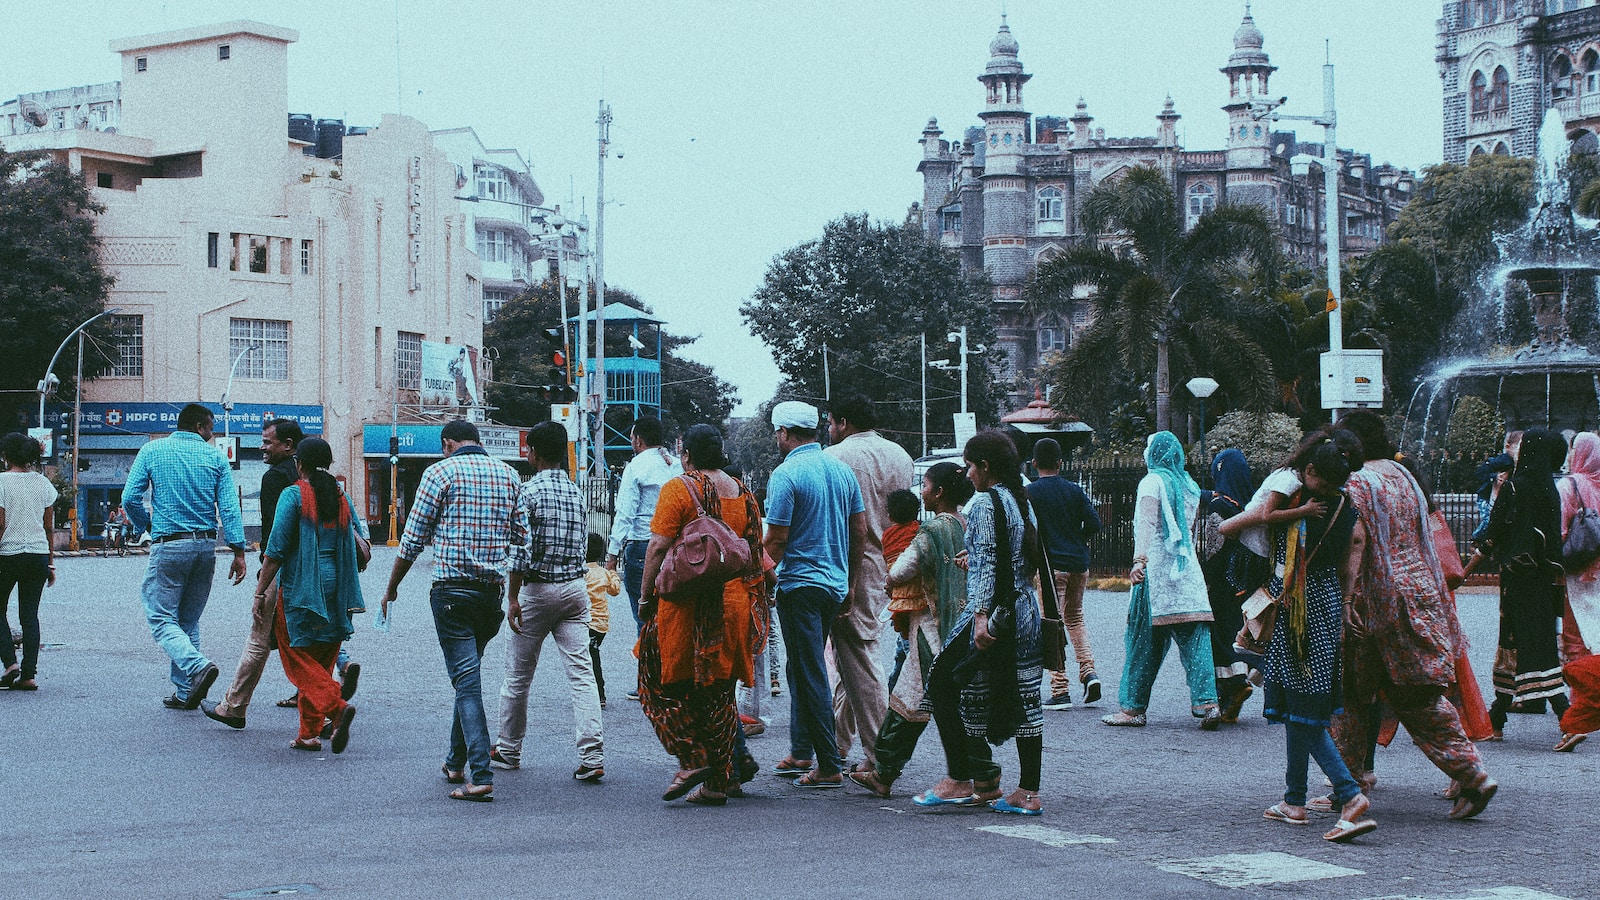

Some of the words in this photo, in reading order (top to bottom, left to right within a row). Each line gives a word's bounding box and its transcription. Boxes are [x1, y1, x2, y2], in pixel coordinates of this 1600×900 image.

[425, 379, 454, 391] TUBELIGHT
[126, 413, 157, 421] HDFC
[398, 434, 414, 446] citi
